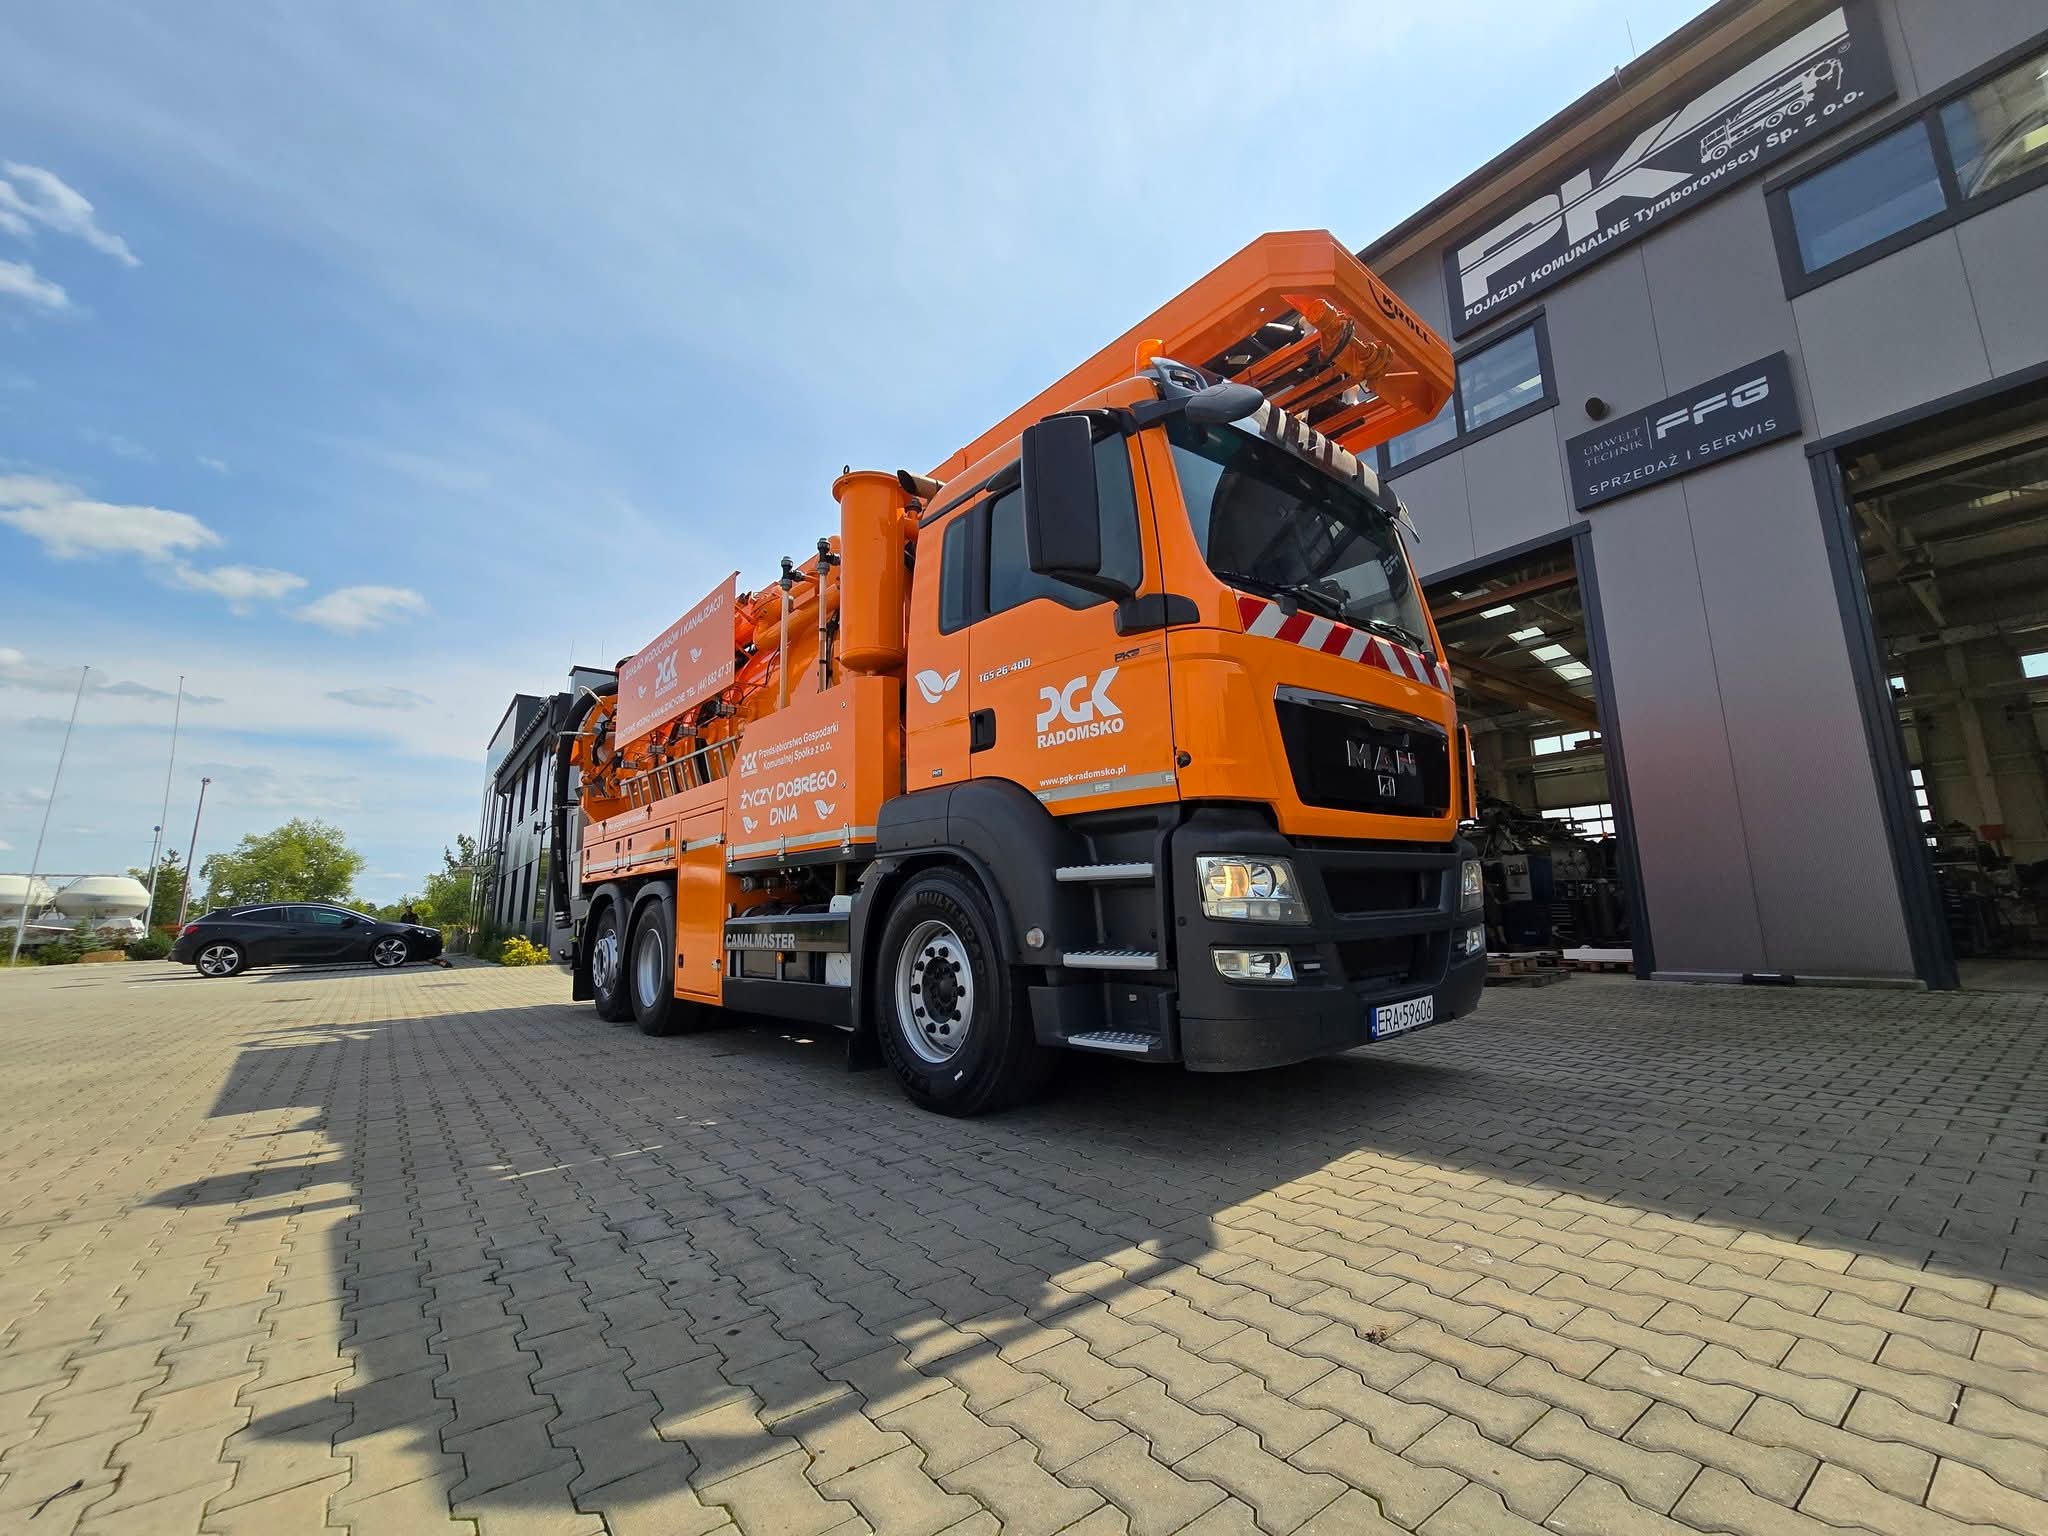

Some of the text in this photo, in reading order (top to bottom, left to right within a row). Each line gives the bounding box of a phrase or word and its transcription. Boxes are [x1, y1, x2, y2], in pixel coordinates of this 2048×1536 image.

[1465, 90, 1864, 320] POJAZDY KOMUNALNE Tymborowscy Sp. z o.o.
[1655, 375, 1769, 440] FFG
[1583, 426, 1642, 456] UMWELT
[1584, 438, 1644, 468] TECHNIK
[1589, 418, 1777, 496] SPRZEDAŻ I SERWIS
[1037, 666, 1122, 733] PGK
[803, 721, 839, 743] Gospodarki
[1037, 718, 1124, 749] RADOMSKO
[1345, 739, 1417, 776] MAN
[740, 768, 838, 810] ŻYCZY DOBREGO
[1039, 764, 1127, 787] www.pgk-radomsko.pl
[769, 803, 798, 826] DNIA
[725, 933, 796, 949] CANALMASTER
[1378, 998, 1432, 1033] ERA 59606
